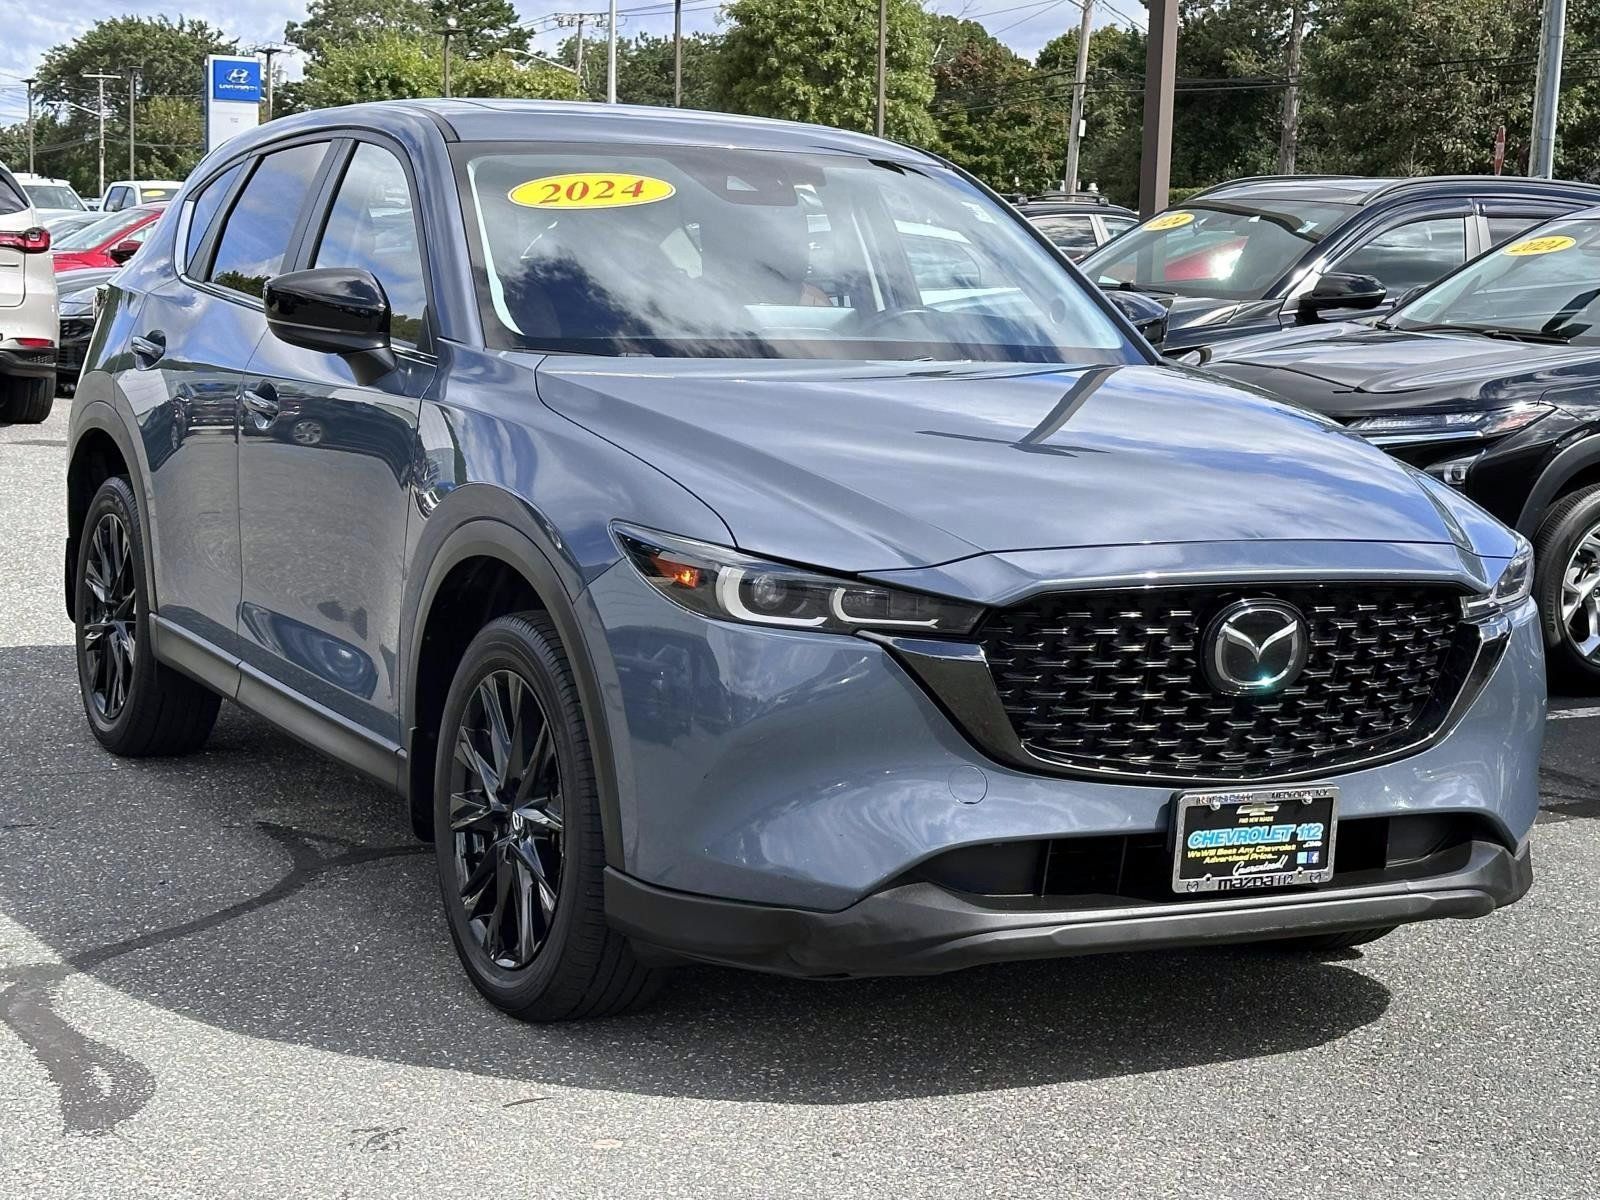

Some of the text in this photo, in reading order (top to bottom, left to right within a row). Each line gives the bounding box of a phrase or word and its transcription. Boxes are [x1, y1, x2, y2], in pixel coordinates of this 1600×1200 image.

[538, 179, 645, 204] 2024
[1187, 823, 1324, 849] CHEVROLET 112
[1238, 846, 1256, 854] Any
[1255, 844, 1297, 853] Chevrolet
